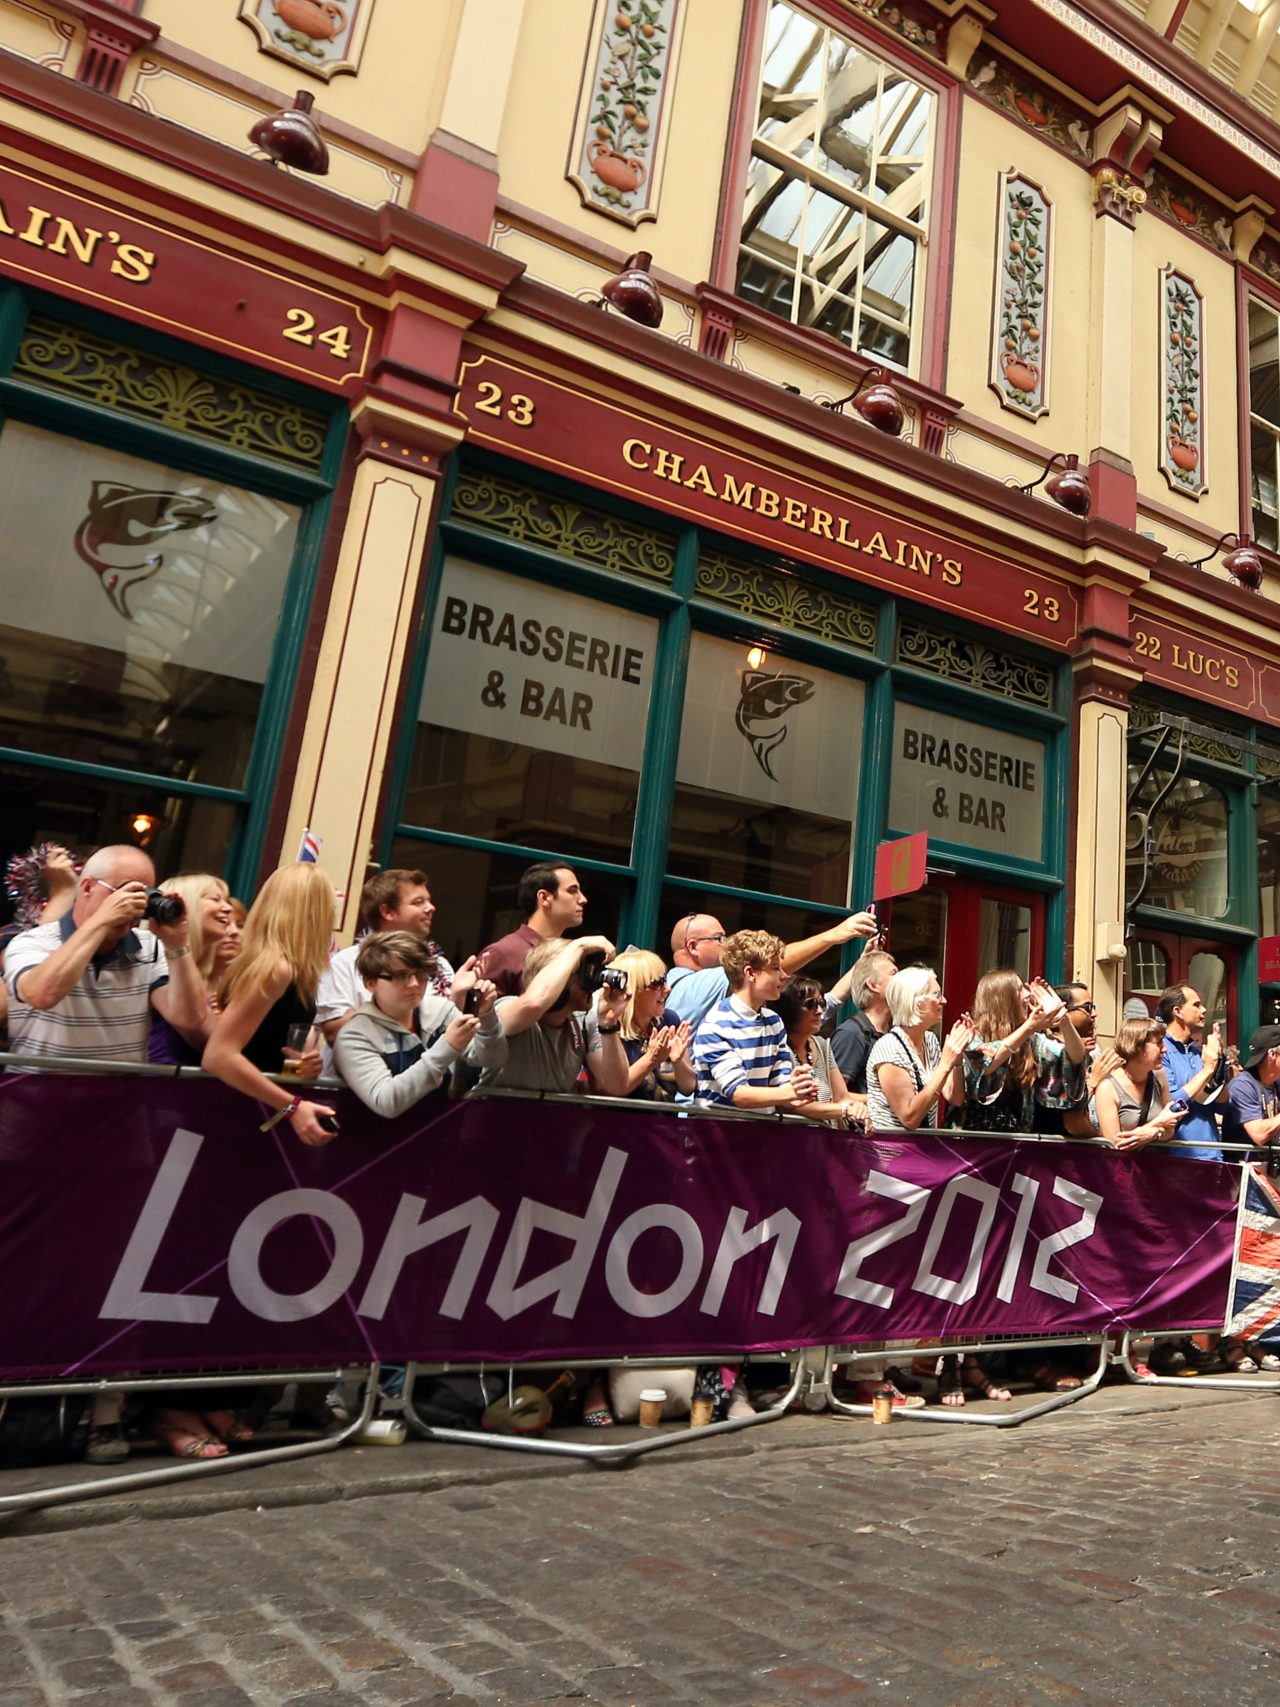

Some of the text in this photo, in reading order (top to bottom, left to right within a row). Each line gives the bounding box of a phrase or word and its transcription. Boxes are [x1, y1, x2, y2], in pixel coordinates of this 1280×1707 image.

[282, 308, 352, 359] 24
[474, 381, 536, 427] 23
[622, 437, 964, 587] CHAMBERLAIN'S
[1023, 589, 1060, 622] 23
[441, 596, 643, 686] BRASSERIE
[1135, 631, 1239, 688] 22 LUC'S
[480, 669, 595, 732] & BAR
[903, 728, 1036, 793] BRASSERIE
[932, 786, 1007, 834] & BAR
[98, 1127, 1104, 1325] London 2012
